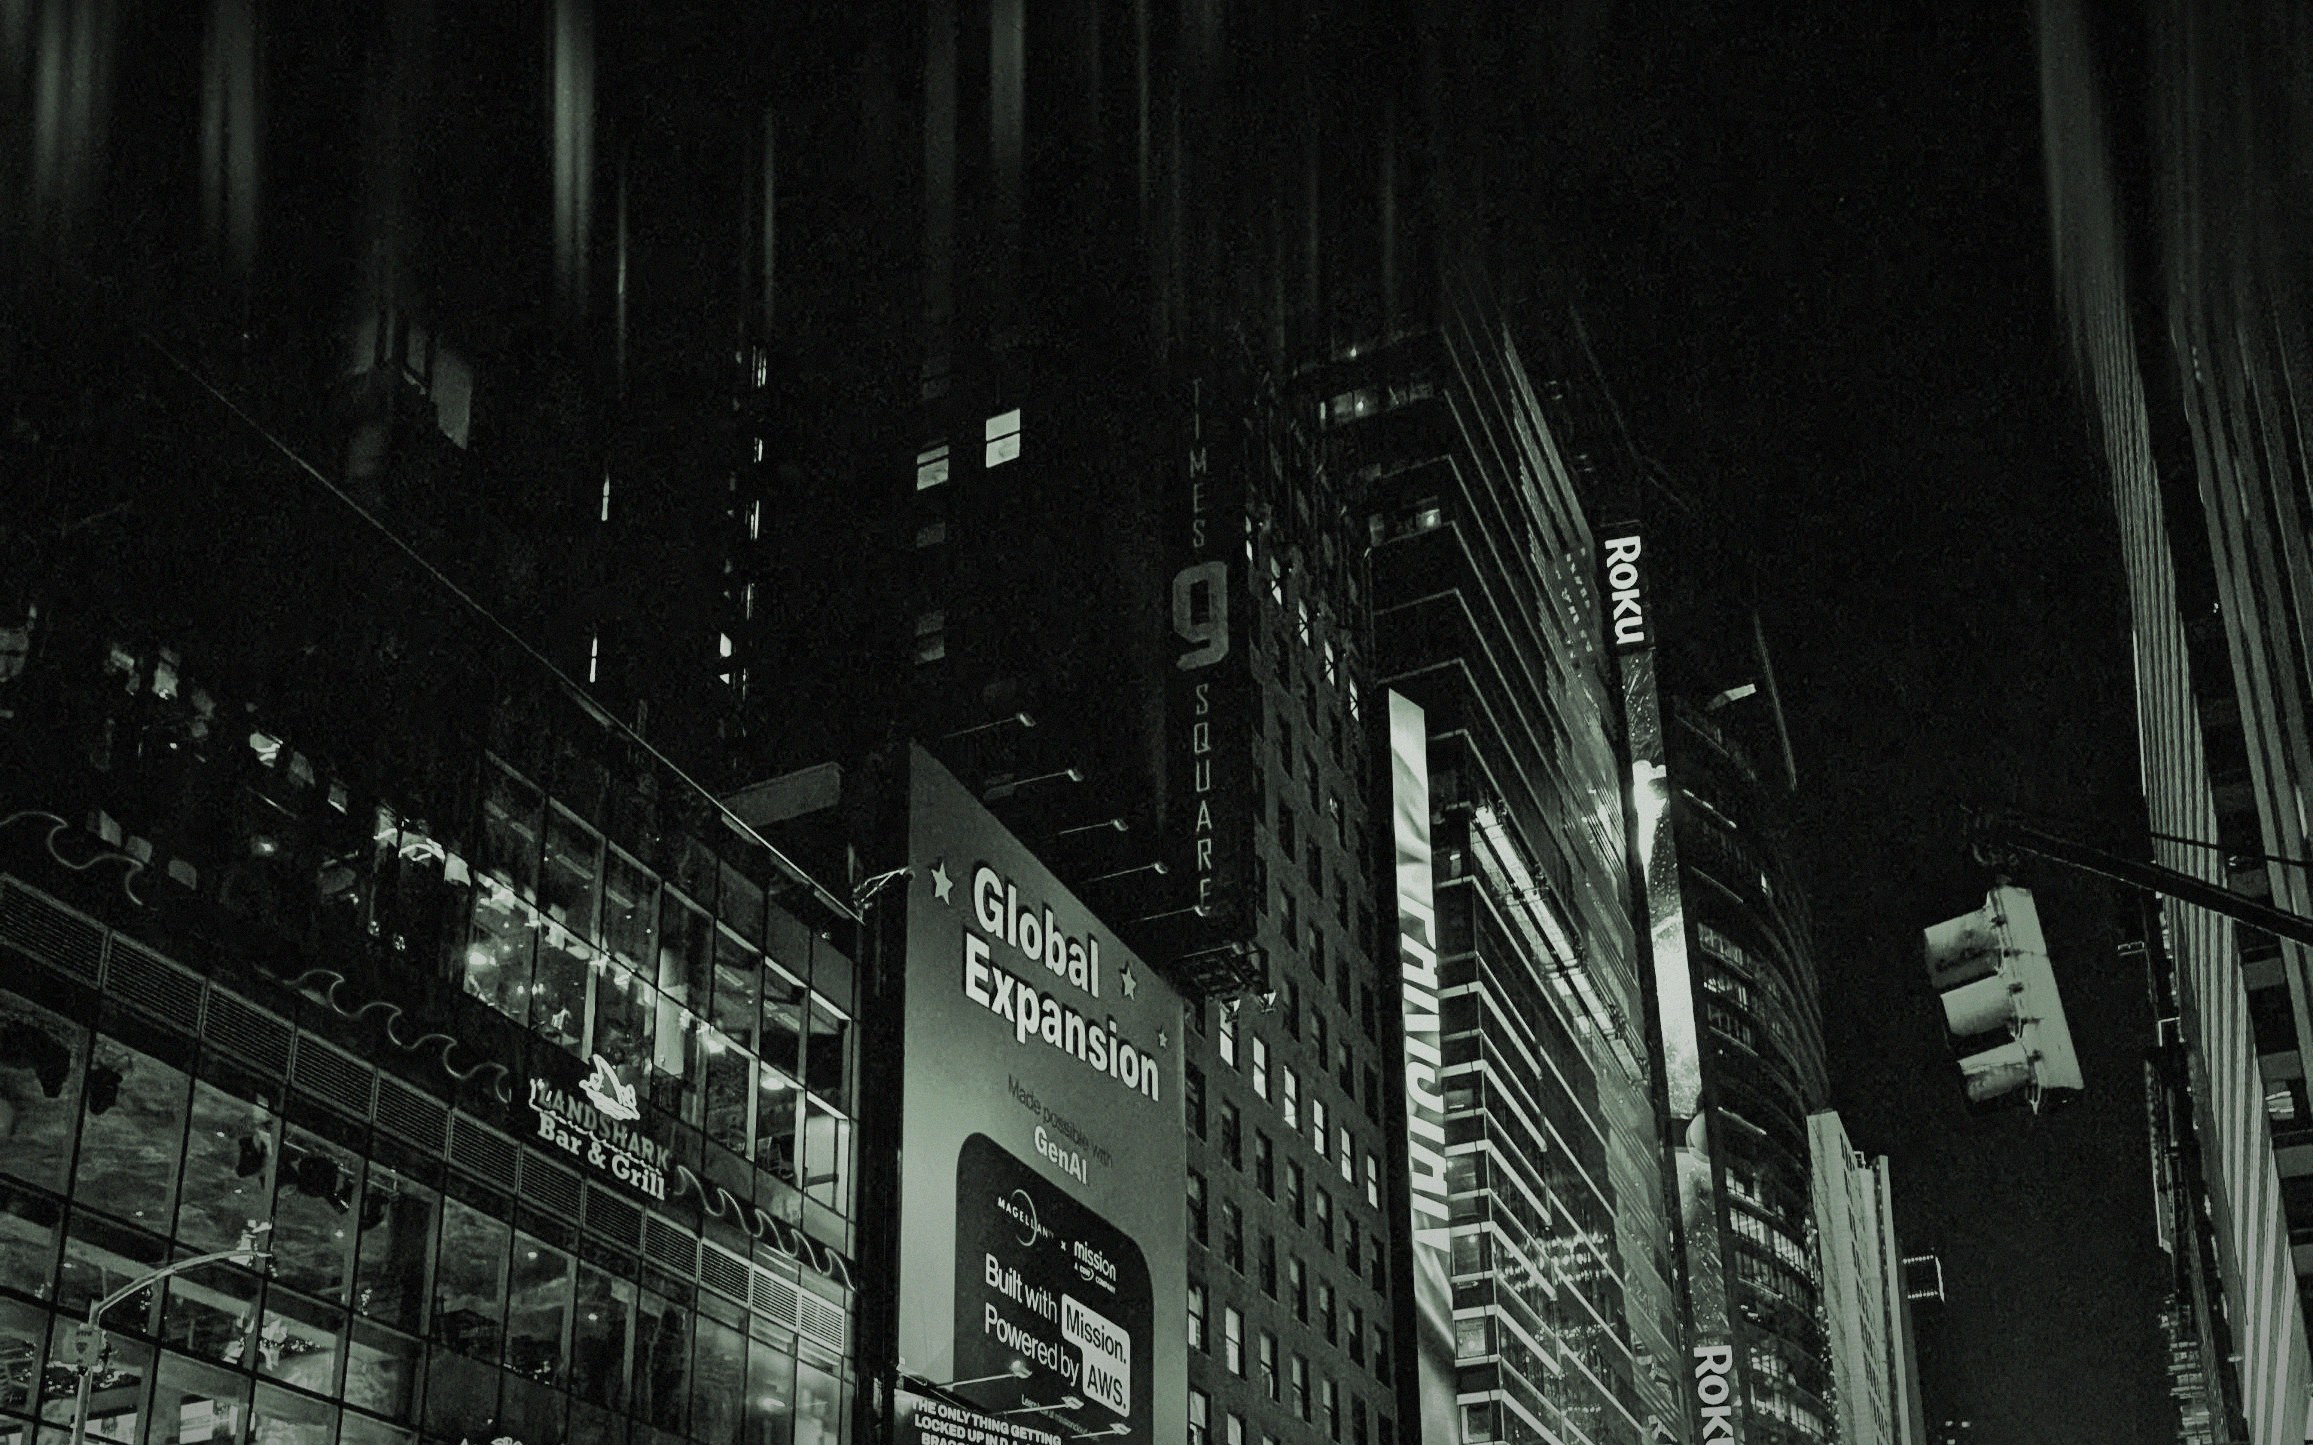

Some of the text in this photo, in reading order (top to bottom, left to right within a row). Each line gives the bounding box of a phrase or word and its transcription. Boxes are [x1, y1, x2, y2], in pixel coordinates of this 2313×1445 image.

[1171, 377, 1230, 914] TIMES 9 SQUARE
[974, 866, 1099, 999] Global
[965, 932, 1159, 1102] Expansion
[537, 1112, 665, 1201] Bar & Grill
[538, 1080, 671, 1172] LANDSHARK
[1008, 1073, 1042, 1115] Made
[1043, 1106, 1089, 1151] possible
[1034, 1125, 1087, 1185] GenAI
[1074, 1240, 1117, 1281] mission
[985, 1252, 1127, 1364] Built with Mission.
[985, 1302, 1127, 1410] Powered by AWS.
[912, 1398, 937, 1415] THE
[938, 1404, 971, 1424] ONLY
[971, 1413, 1009, 1435] THING
[1010, 1424, 1062, 1445] GETTING
[914, 1413, 966, 1439] LOCKED
[967, 1428, 985, 1444] UP
